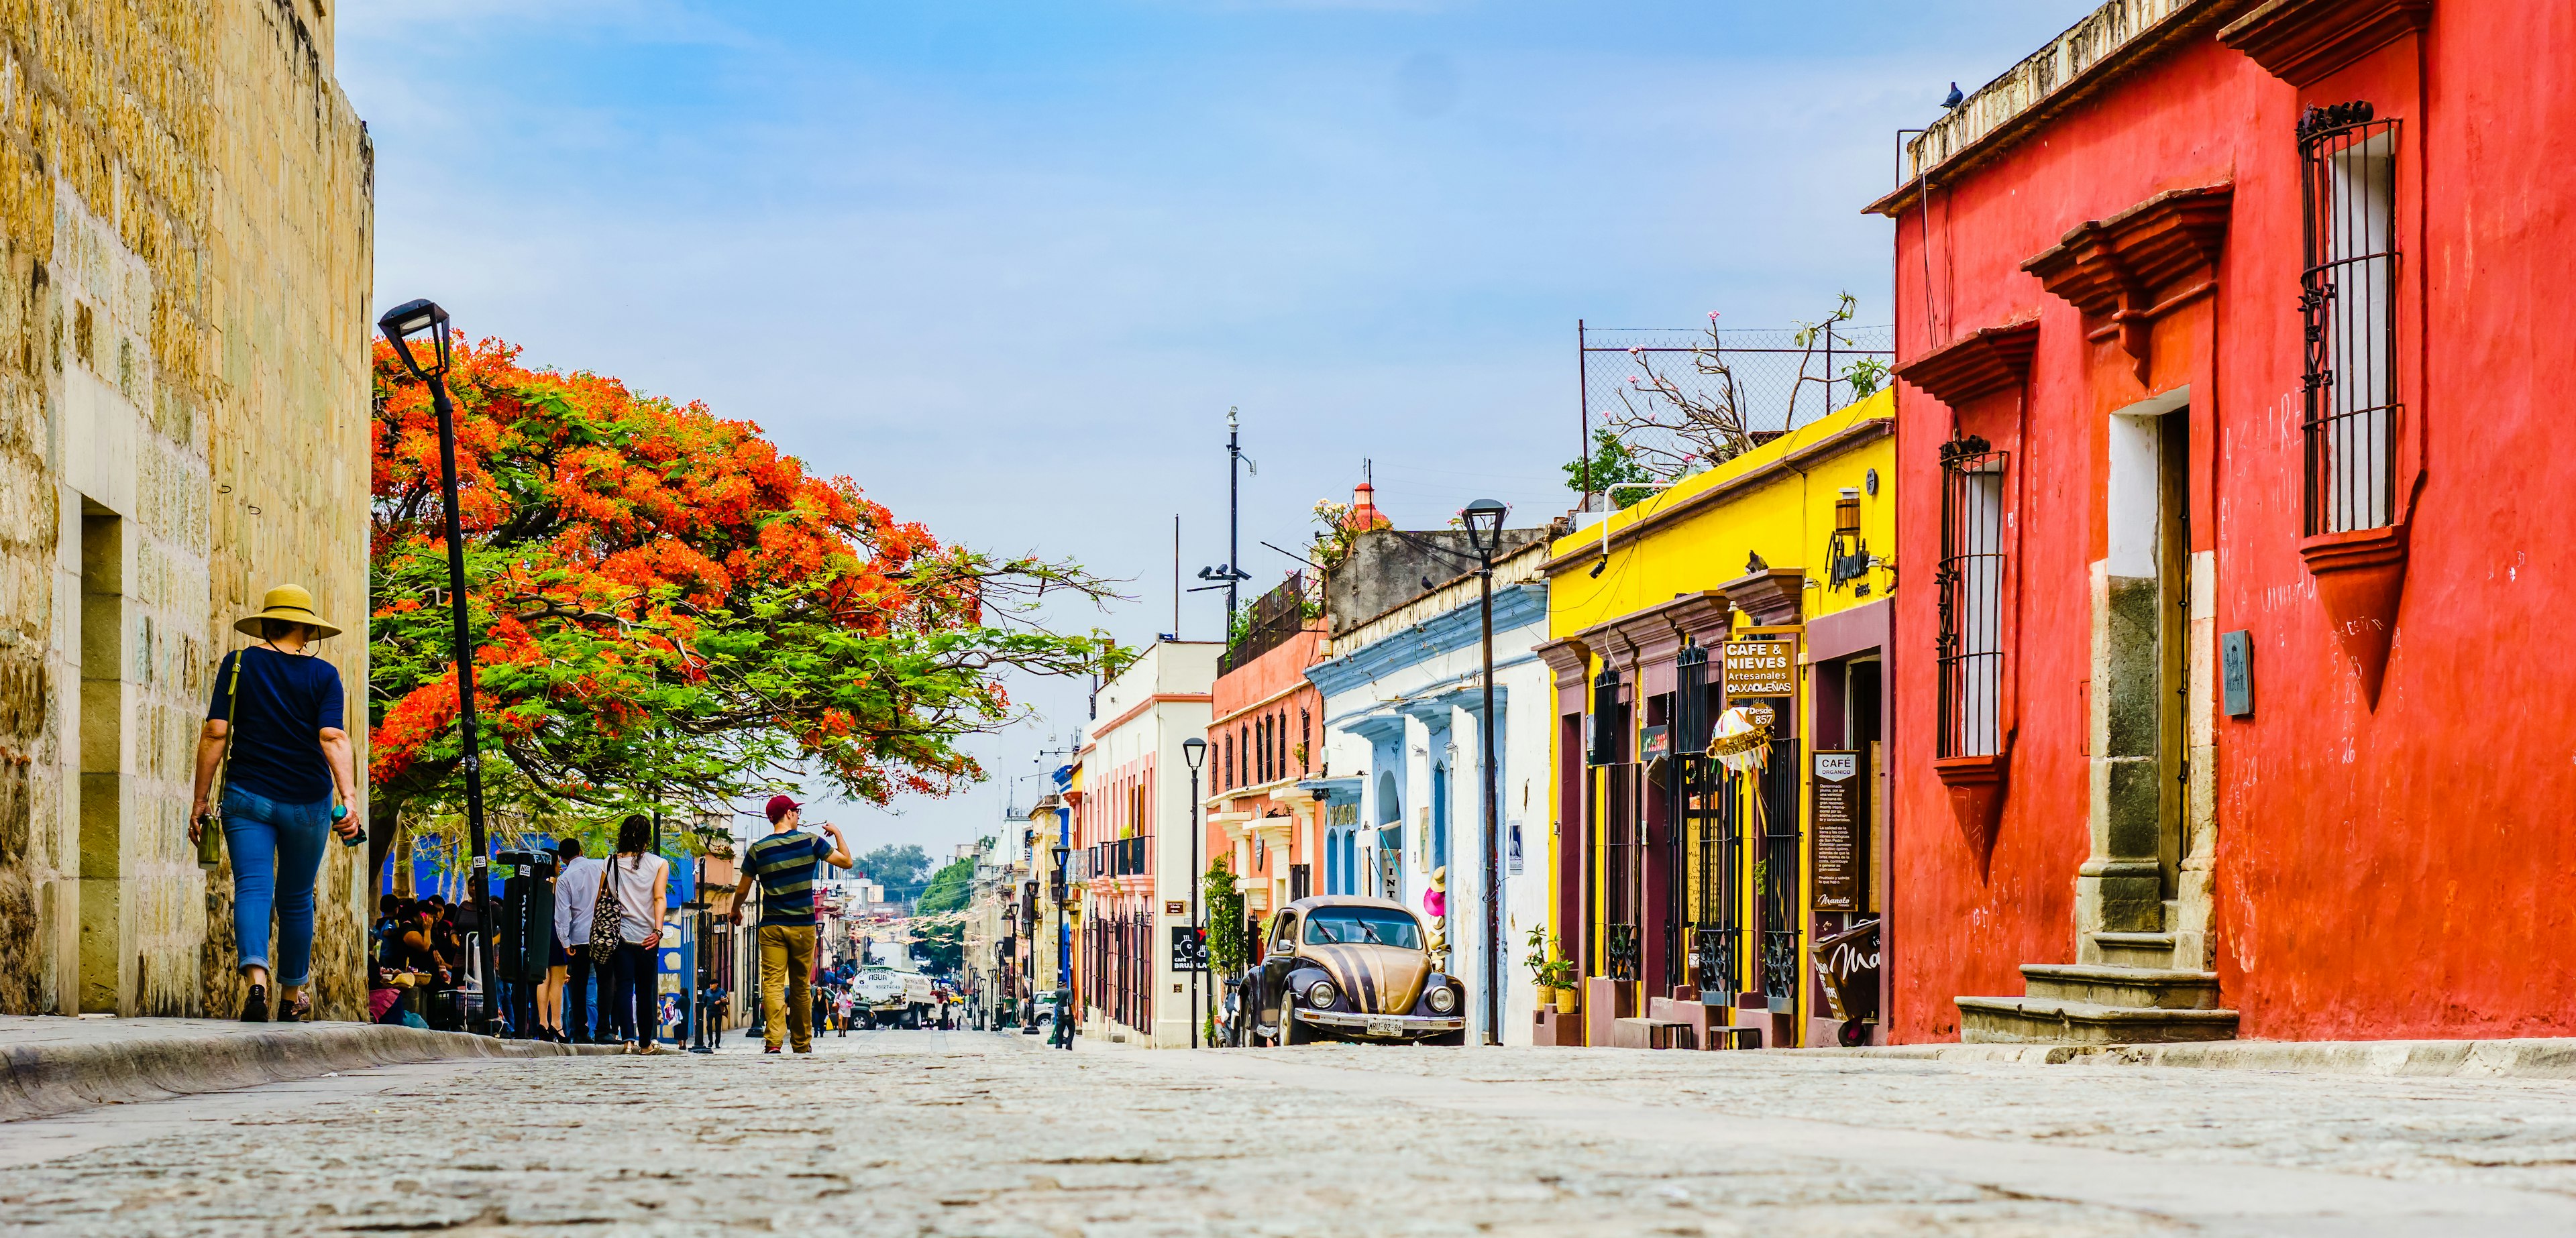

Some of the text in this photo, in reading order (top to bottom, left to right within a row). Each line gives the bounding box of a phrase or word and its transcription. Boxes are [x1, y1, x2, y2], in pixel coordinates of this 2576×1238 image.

[1726, 644, 1782, 656] CAFE &
[1727, 657, 1786, 669] NIEVES
[1727, 671, 1786, 681] Artesanales
[1749, 706, 1772, 715] Desde
[1755, 715, 1772, 725] 857
[1822, 757, 1851, 768] CAFÉ
[521, 865, 530, 873] NOS
[1817, 894, 1850, 905] Manolo
